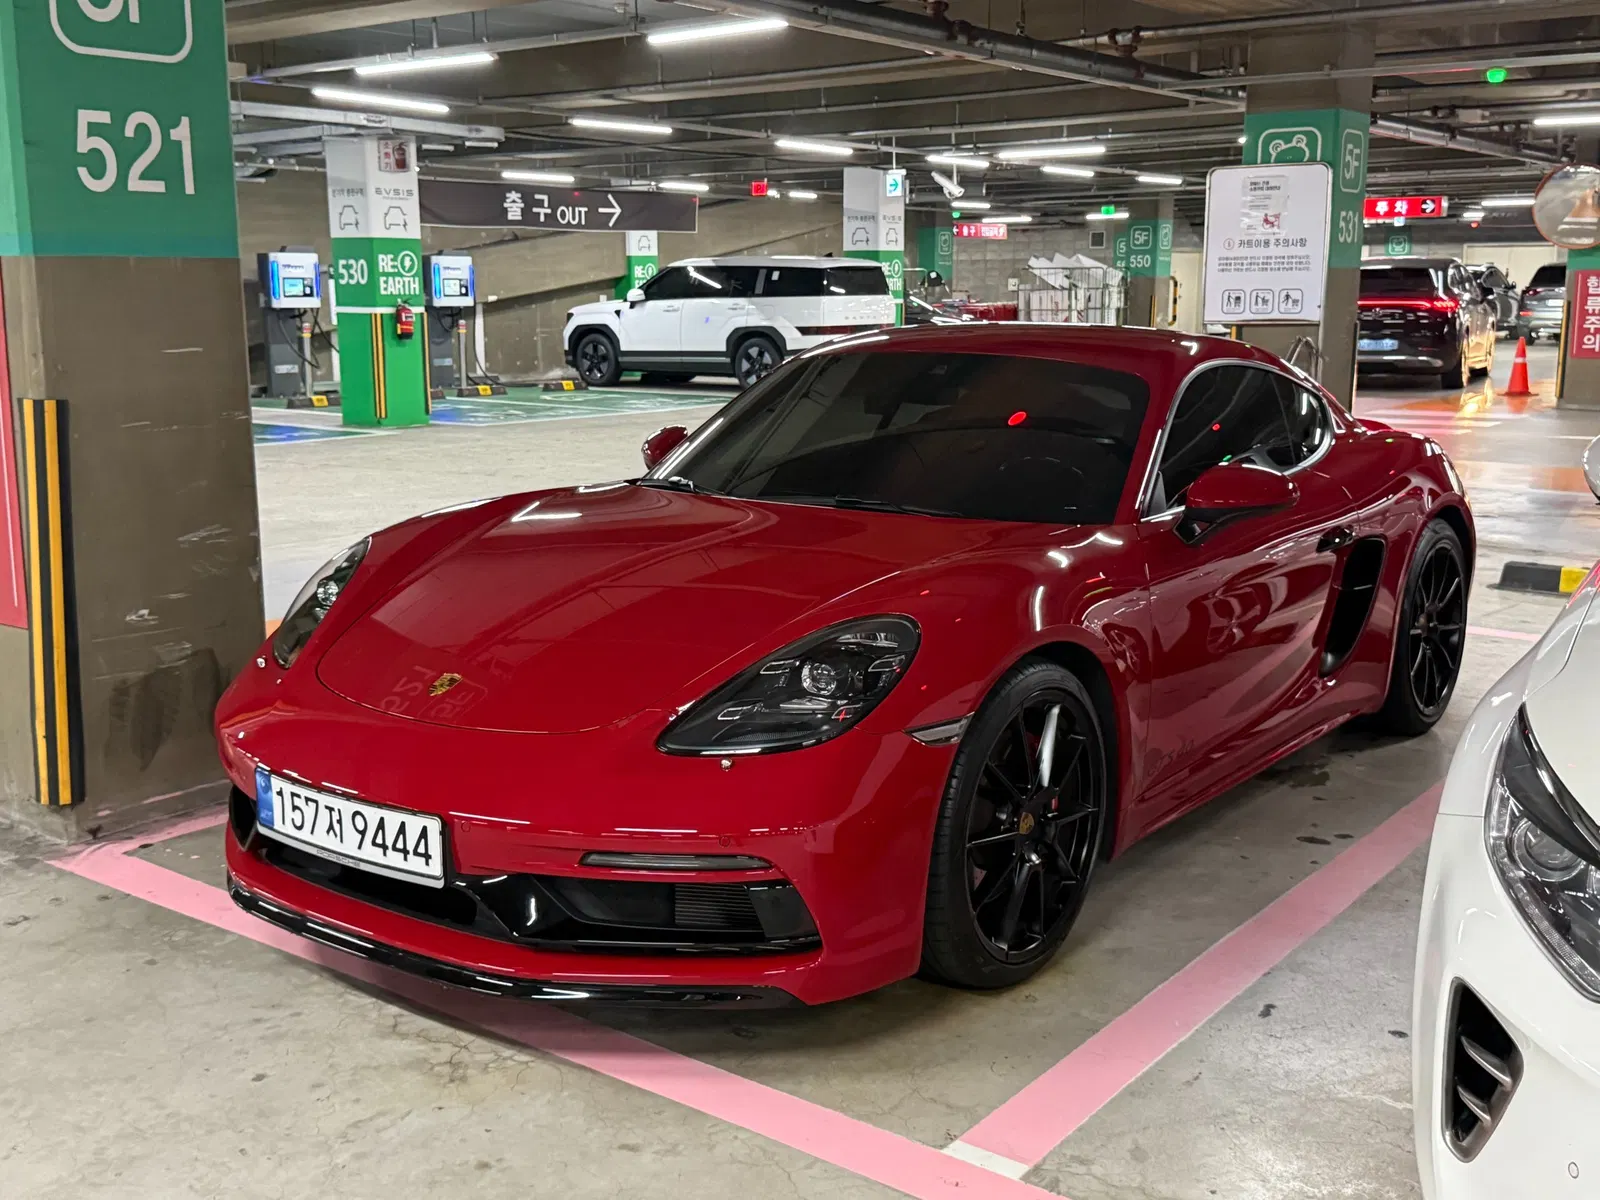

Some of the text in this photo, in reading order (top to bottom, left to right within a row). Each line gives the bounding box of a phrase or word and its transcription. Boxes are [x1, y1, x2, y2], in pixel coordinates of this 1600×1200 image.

[76, 109, 195, 195] 521
[1344, 144, 1361, 179] 5F
[375, 187, 414, 197] EVSIS
[556, 206, 588, 225] OUT
[1338, 210, 1359, 243] 531
[1134, 230, 1149, 245] 5F
[1238, 238, 1308, 249] 카트이용 주의사항
[1129, 254, 1151, 268] 550
[338, 258, 368, 285] 530
[379, 277, 420, 295] EARTH
[276, 786, 432, 866] 157저 9444
[316, 849, 361, 867] PORSCHE
